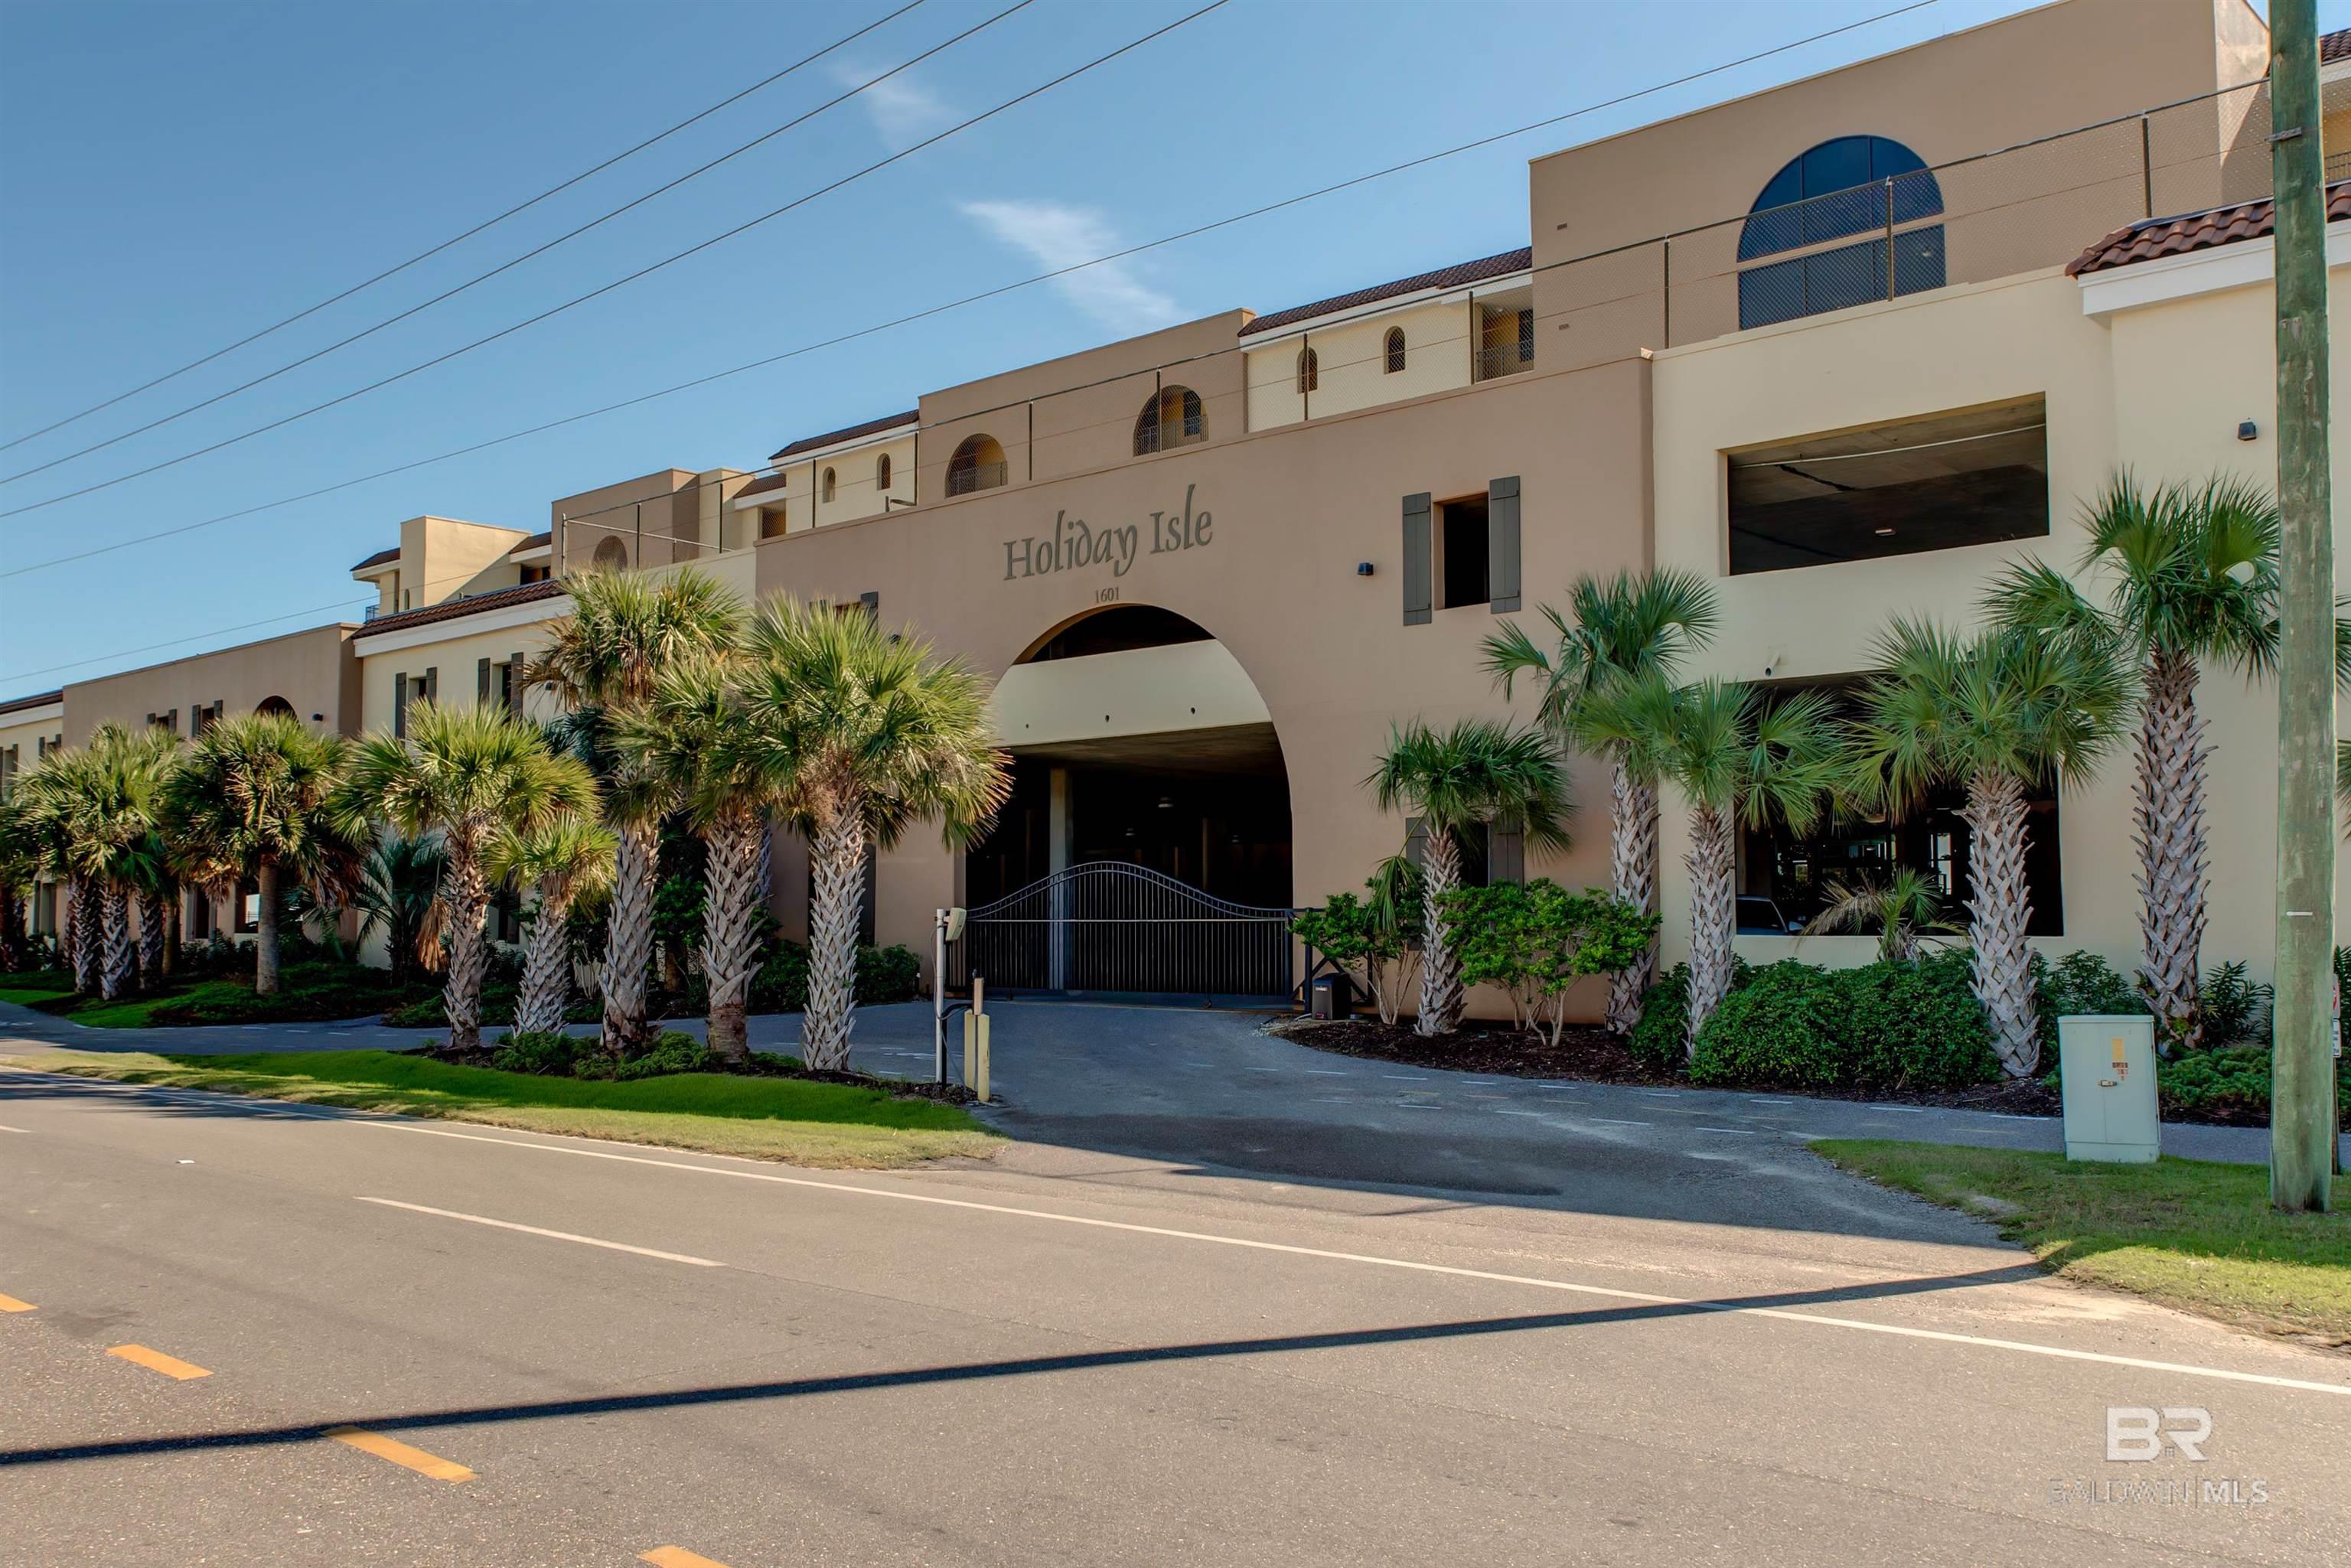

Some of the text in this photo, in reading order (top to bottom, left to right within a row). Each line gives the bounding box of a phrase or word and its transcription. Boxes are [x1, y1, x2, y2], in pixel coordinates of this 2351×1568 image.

[1003, 483, 1213, 581] Holiday Isle
[1094, 586, 1120, 604] 1601
